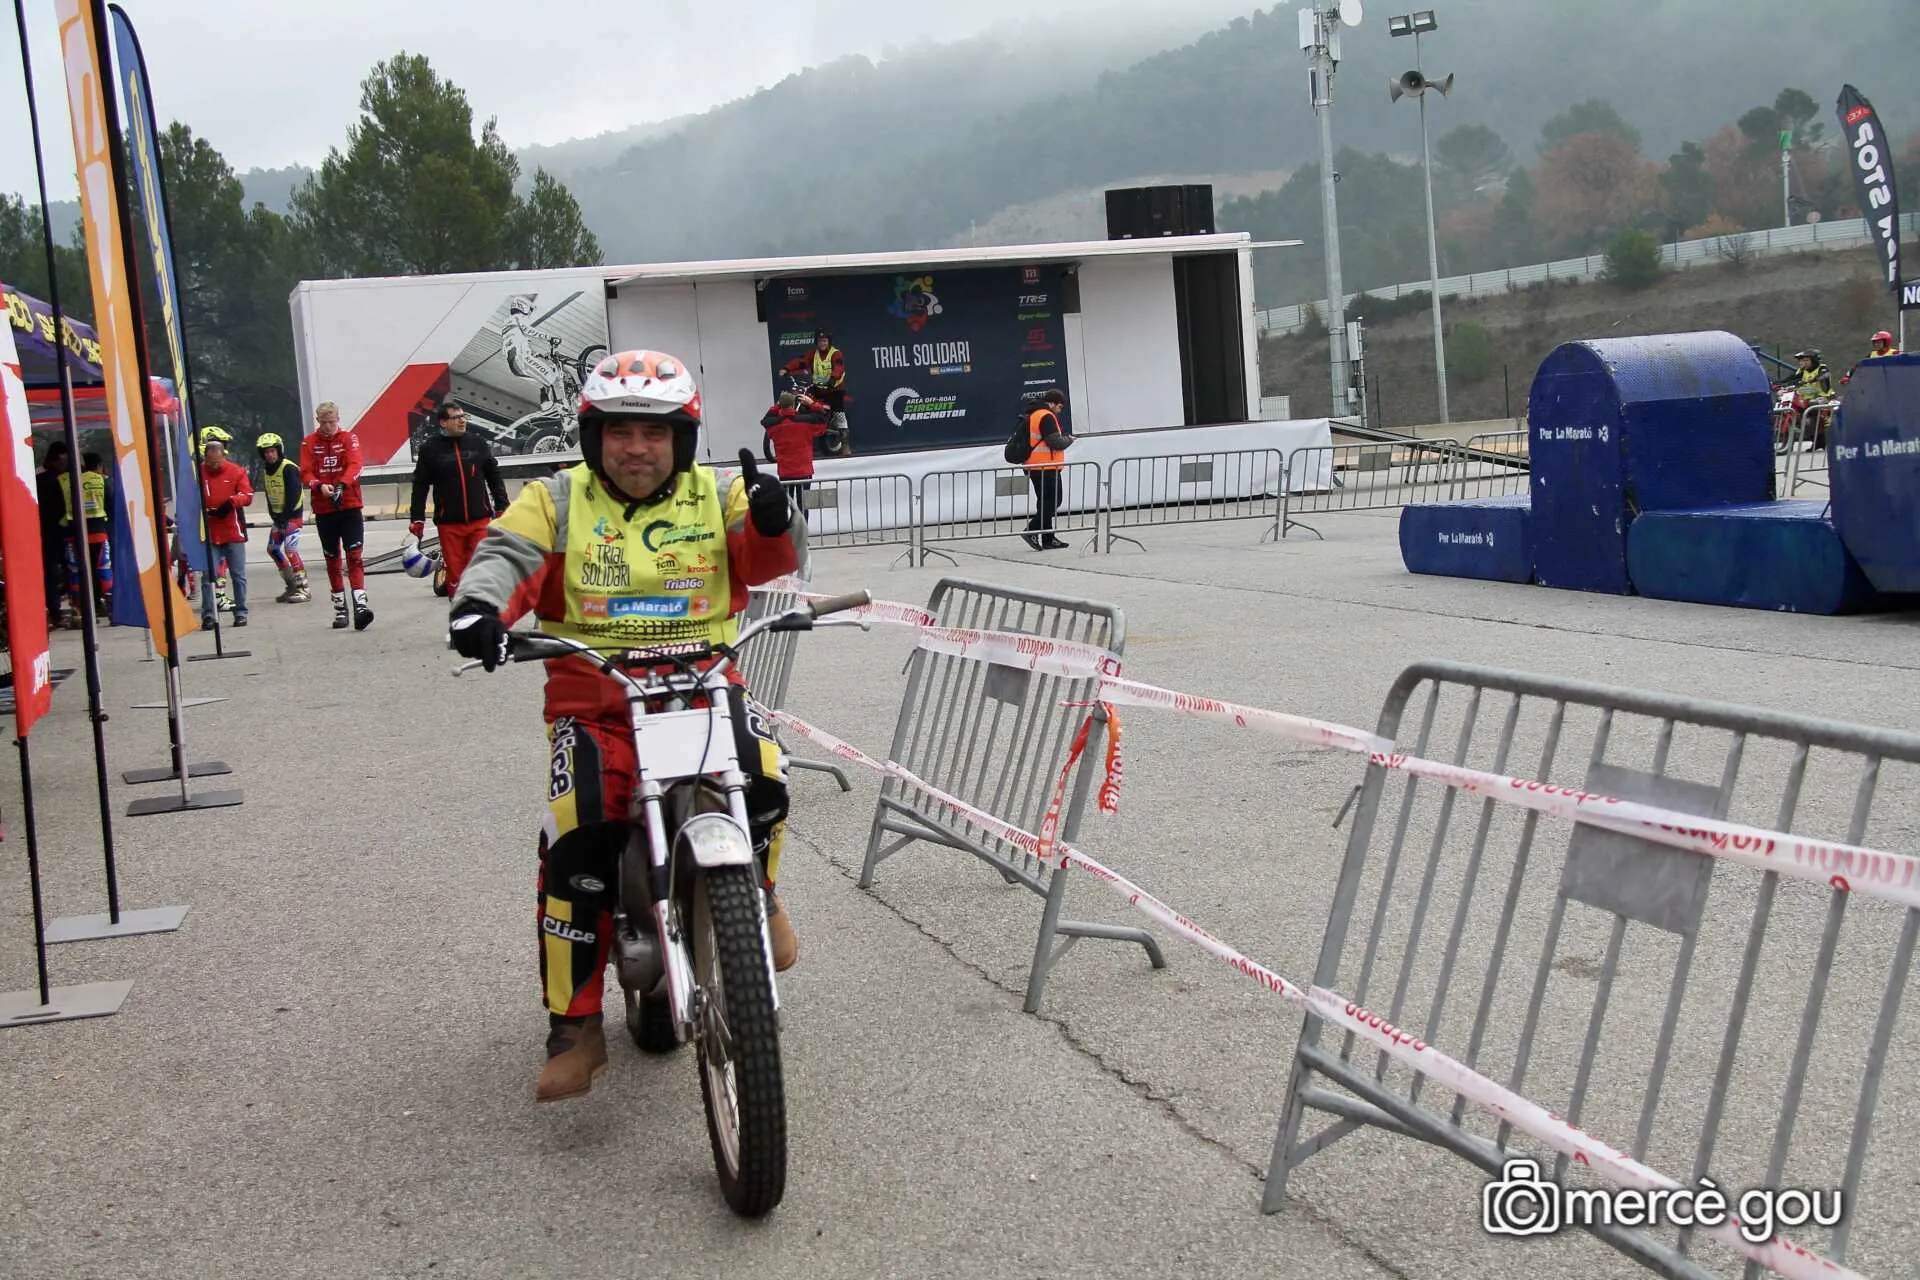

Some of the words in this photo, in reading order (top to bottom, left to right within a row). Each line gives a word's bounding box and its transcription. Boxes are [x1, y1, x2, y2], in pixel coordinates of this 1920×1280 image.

[872, 345, 911, 369] TRIAL
[913, 340, 971, 366] SOLIDARI
[904, 401, 956, 413] CIRCUIT
[902, 409, 967, 421] PARCMOTOR
[1835, 444, 1858, 460] Per
[664, 577, 704, 590] TrialGo
[583, 602, 608, 613] Per
